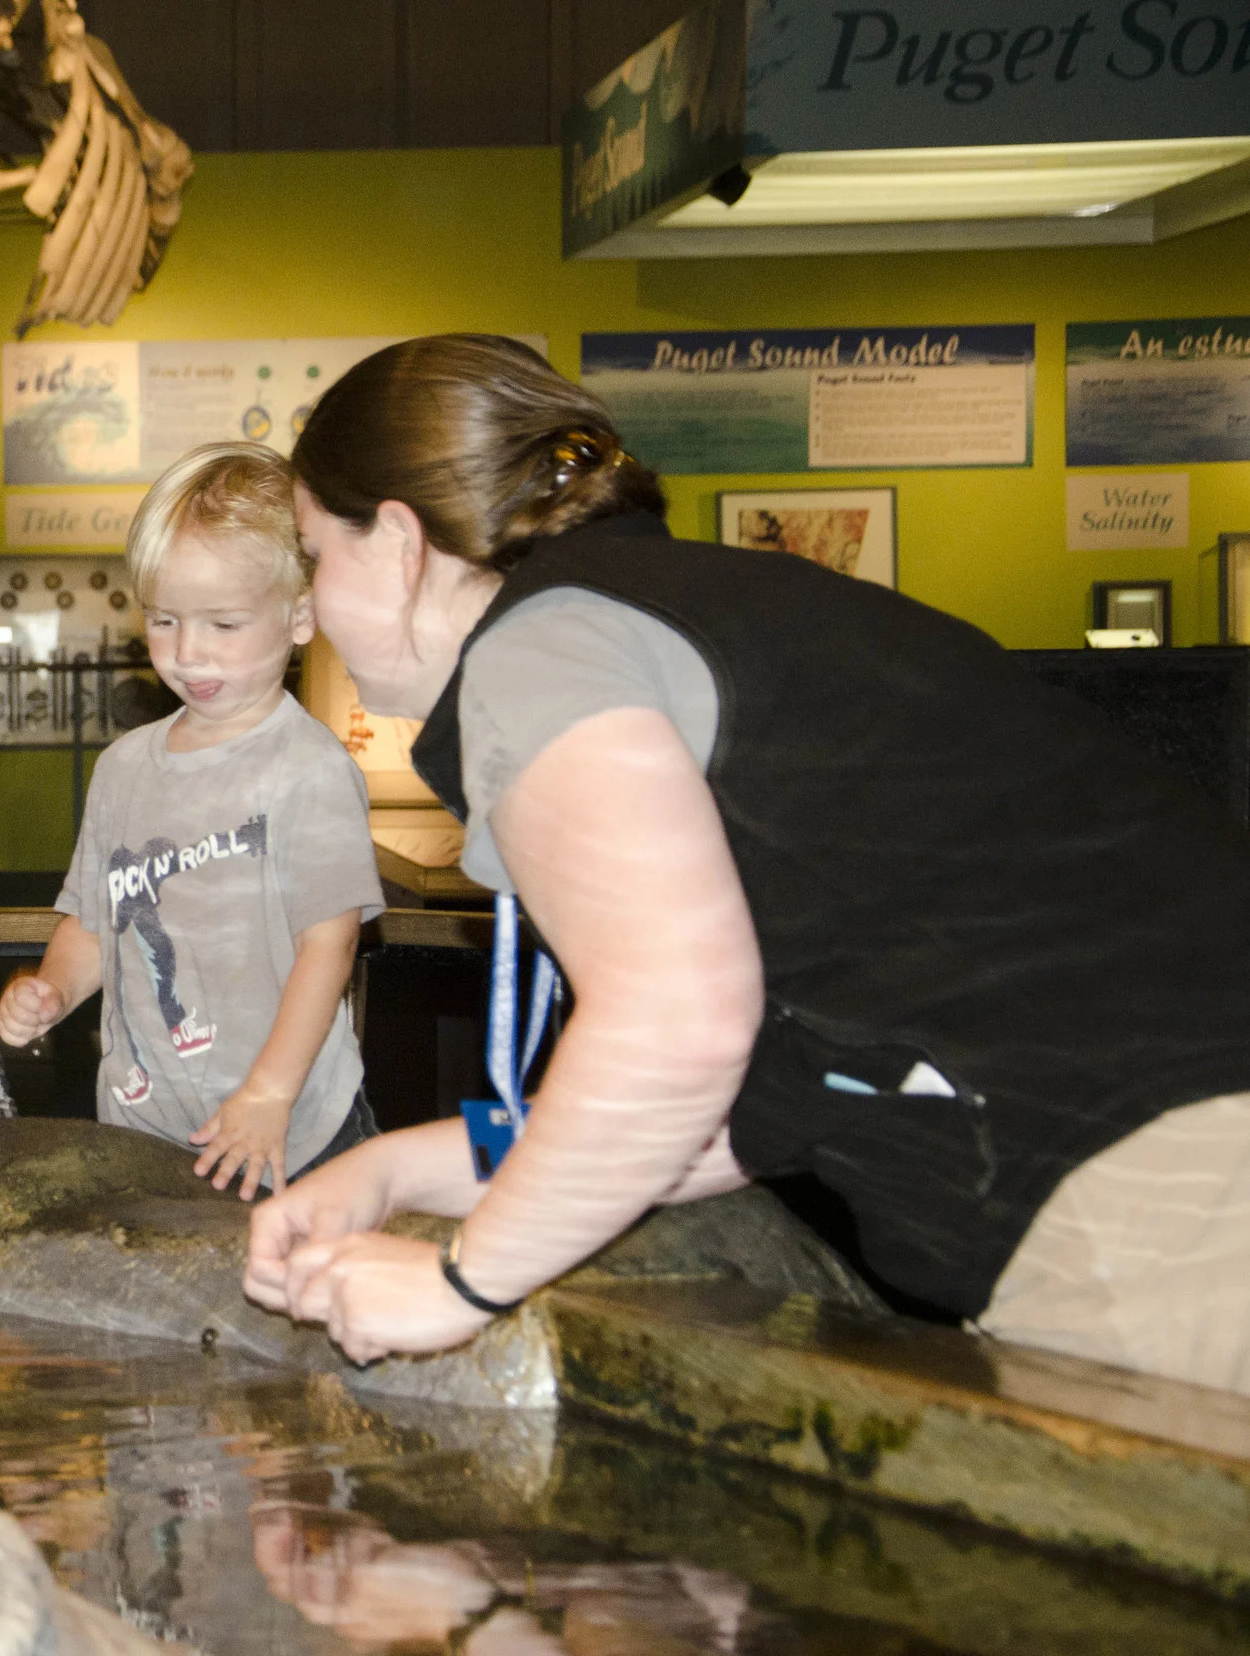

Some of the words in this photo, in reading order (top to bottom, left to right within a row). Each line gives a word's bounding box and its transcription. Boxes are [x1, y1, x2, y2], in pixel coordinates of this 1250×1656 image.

[816, 7, 1096, 105] Puget
[653, 339, 737, 374] Puget
[749, 335, 840, 371] Sound
[852, 333, 960, 366] Model
[1119, 328, 1165, 359] An
[1177, 325, 1250, 358] estu
[1102, 488, 1173, 508] Water
[19, 504, 78, 533] Tide
[1080, 510, 1174, 534] Salinity
[178, 829, 250, 872] ROLL
